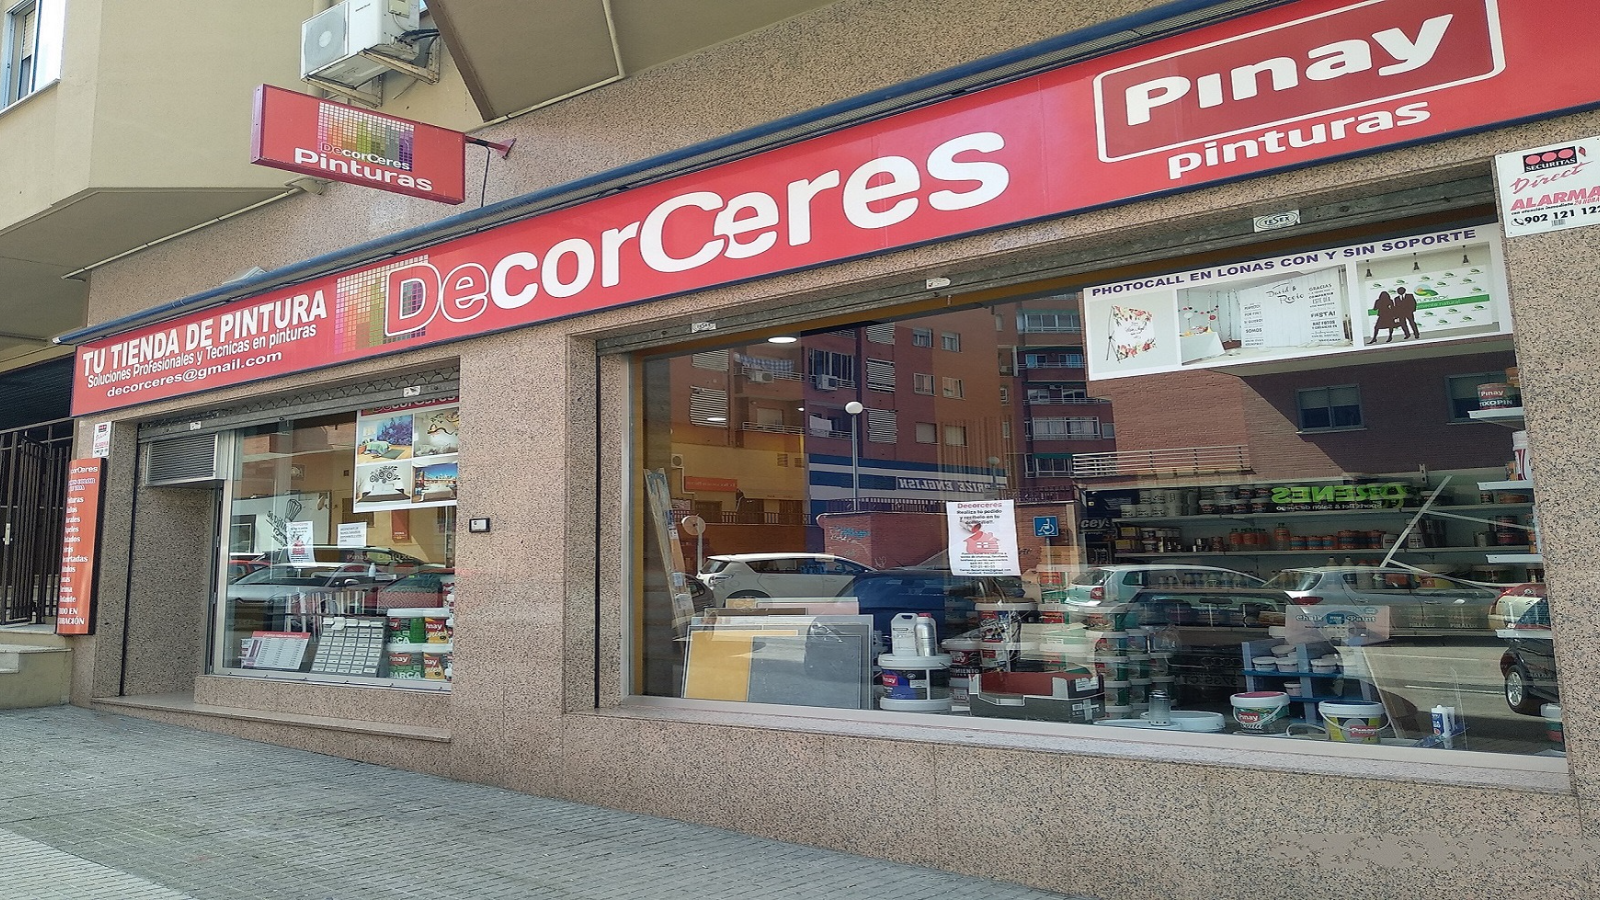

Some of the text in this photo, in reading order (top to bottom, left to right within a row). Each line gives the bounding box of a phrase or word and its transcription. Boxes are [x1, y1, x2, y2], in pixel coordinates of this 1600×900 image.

[1125, 13, 1454, 126] Pinay
[320, 142, 410, 171] DecorCeres
[1167, 101, 1432, 180] pinturas
[1525, 157, 1577, 172] SECURITAS
[293, 147, 433, 191] Pinturas
[1510, 160, 1594, 195] Direct
[385, 130, 1011, 338] DecorCeres
[1524, 213, 1549, 224] 902
[1553, 209, 1575, 220] 121
[1092, 229, 1477, 297] PHOTOCALL EN LONAS CON Y SIN SOPORTE
[1308, 283, 1332, 292] GRACIAS
[82, 289, 328, 377] TU TIENDA DE PINTURA
[87, 322, 317, 389] Soluciones Profesionales y Tecnicas en pinturas
[106, 350, 283, 398] decorceres@gmail.com
